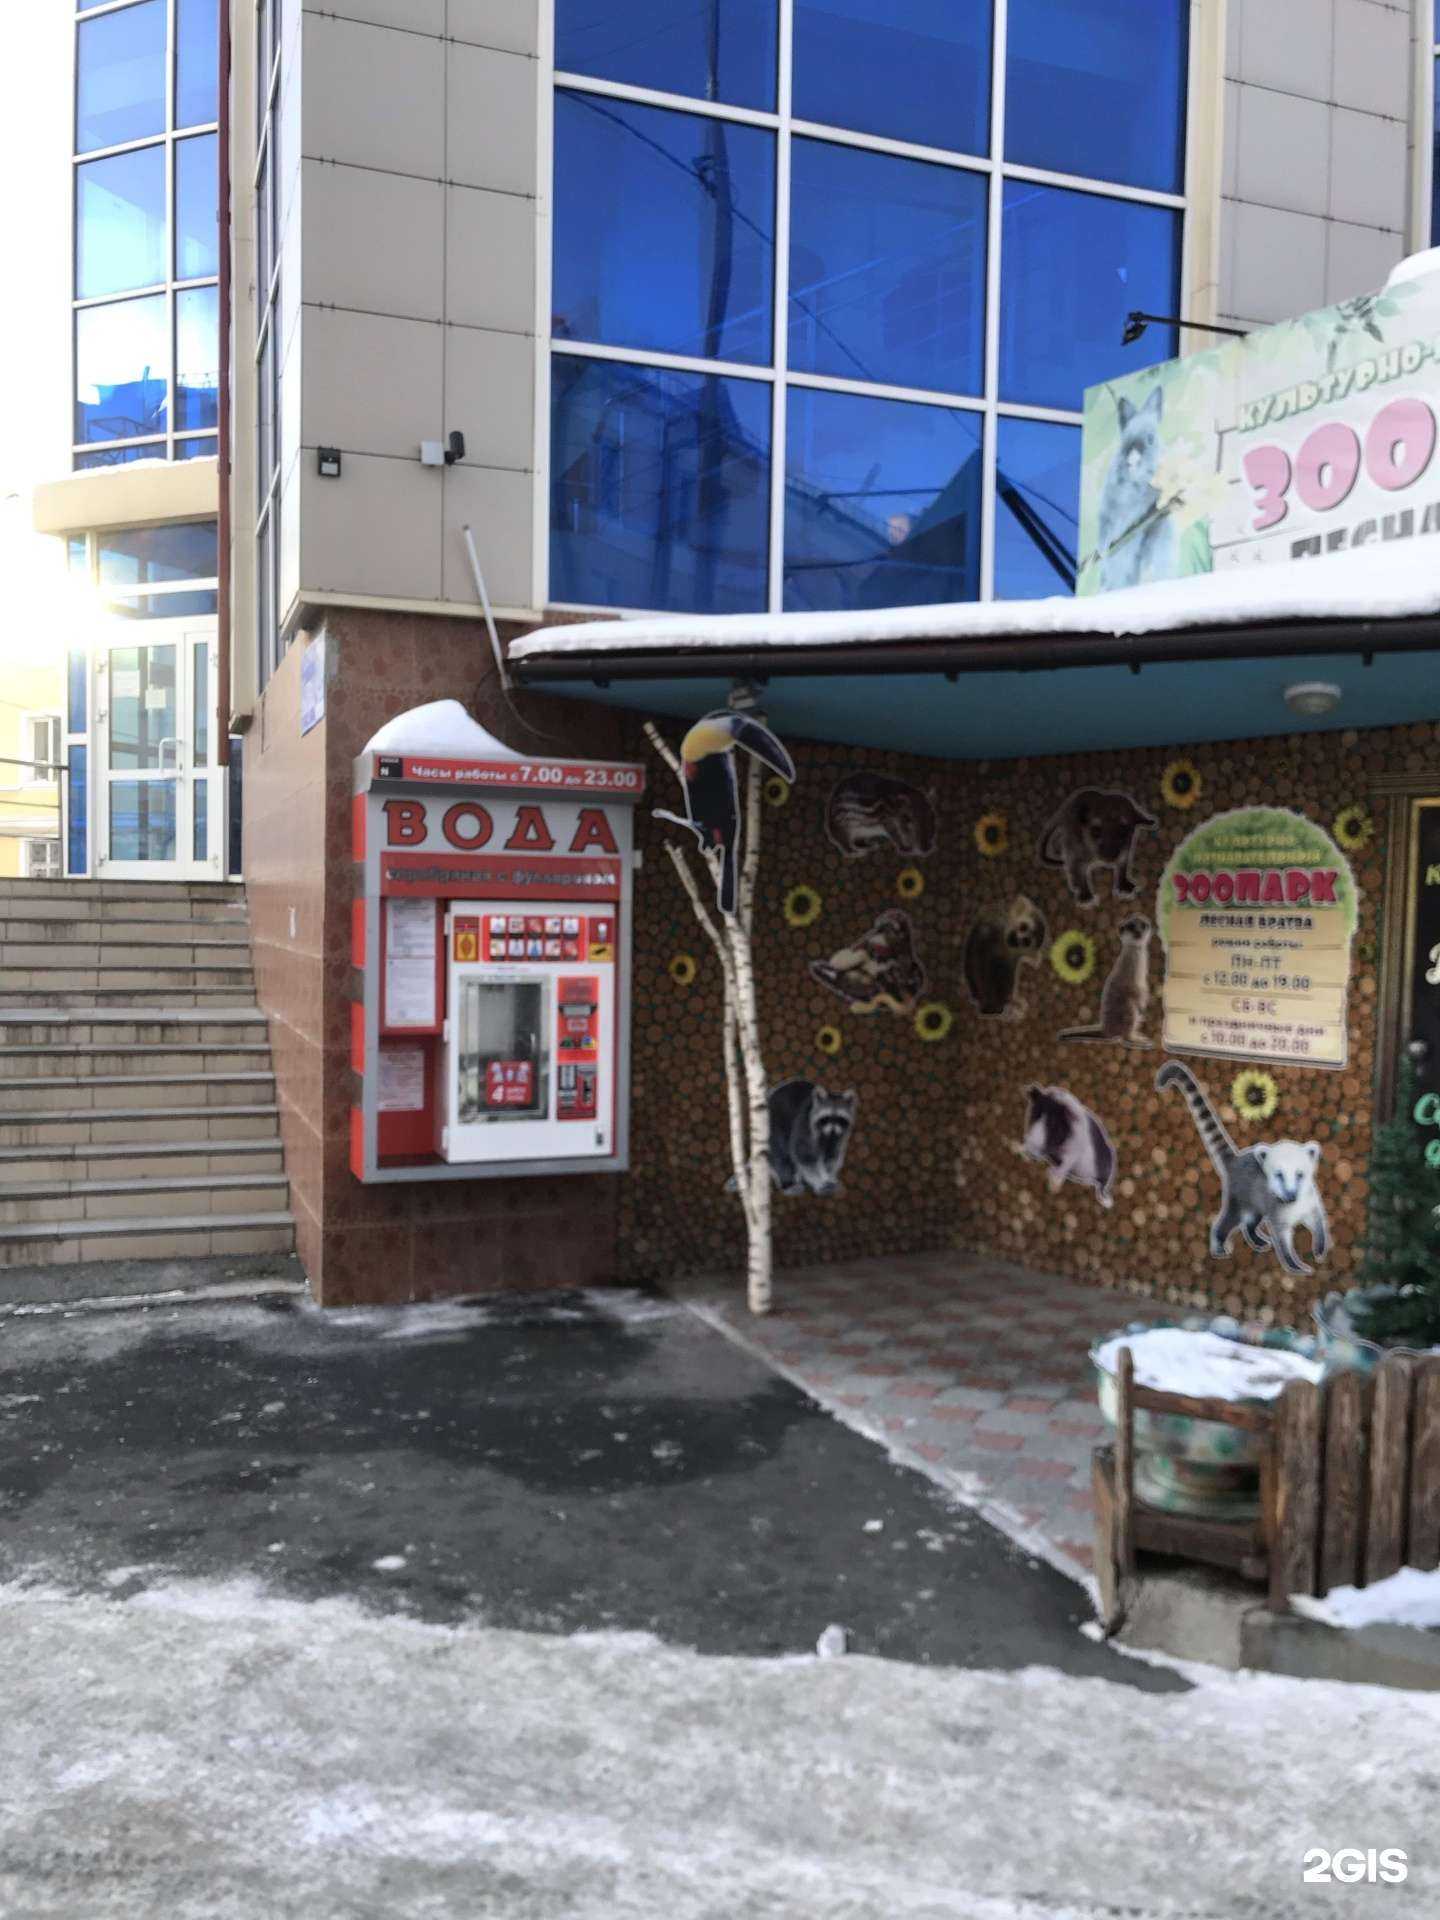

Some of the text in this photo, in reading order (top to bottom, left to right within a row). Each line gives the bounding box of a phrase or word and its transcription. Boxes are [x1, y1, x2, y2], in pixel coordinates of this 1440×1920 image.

[412, 764, 451, 779] Часы
[455, 768, 507, 782] работы
[520, 765, 563, 783] 7.00
[584, 769, 638, 788] 23.00
[382, 799, 620, 854] ВОДА
[1172, 867, 1339, 906] ЗООПАРК
